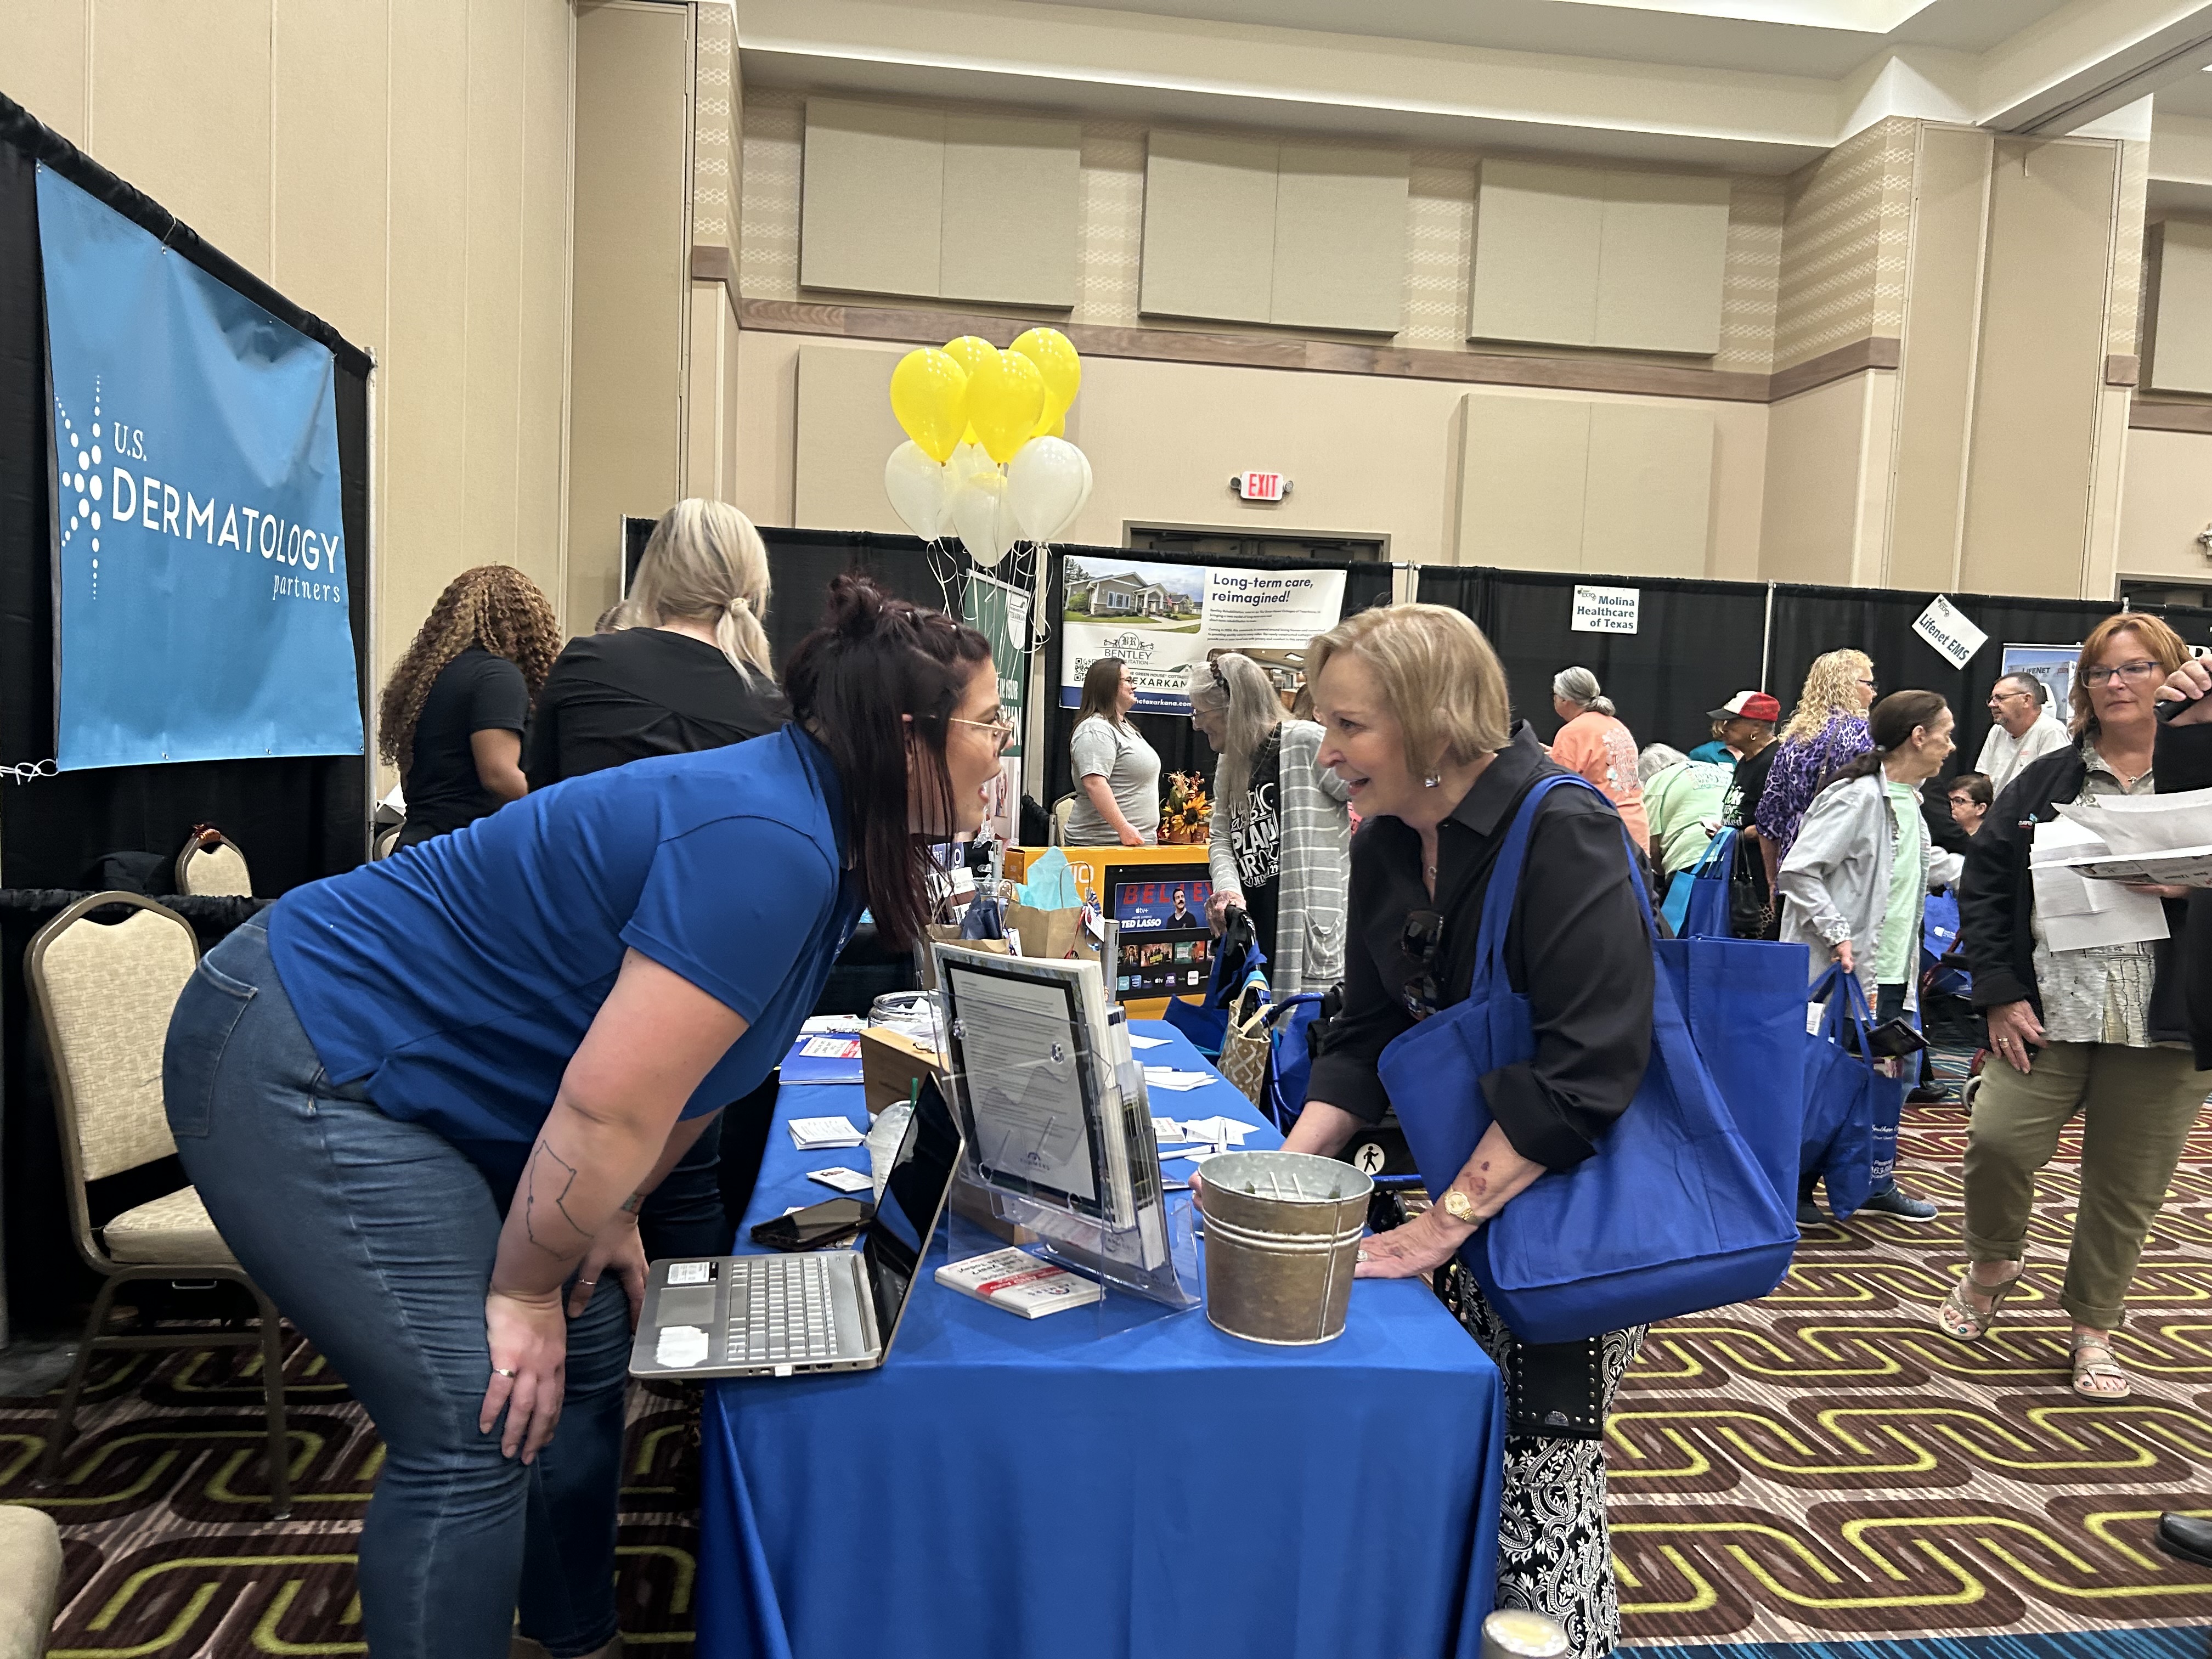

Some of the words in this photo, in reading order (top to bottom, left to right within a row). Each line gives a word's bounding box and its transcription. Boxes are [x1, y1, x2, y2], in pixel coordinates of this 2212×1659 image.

[114, 422, 147, 461] U.S.
[1248, 473, 1278, 497] EXIT
[112, 466, 339, 573] DERMATOLOGY
[272, 574, 341, 603] partners
[1214, 573, 1282, 590] Long-term
[1285, 578, 1313, 589] care,
[1212, 590, 1291, 606] reimagined!
[1598, 596, 1635, 606] Molina
[1577, 606, 1635, 618] Healthcare
[1590, 618, 1601, 627] of
[1604, 619, 1634, 629] Texas
[1919, 613, 1950, 646] Lifenet
[1946, 639, 1970, 661] EMS
[1105, 648, 1152, 660] BENTLEY
[1132, 677, 1187, 688] EXARKAN
[1137, 918, 1161, 928] LASSO
